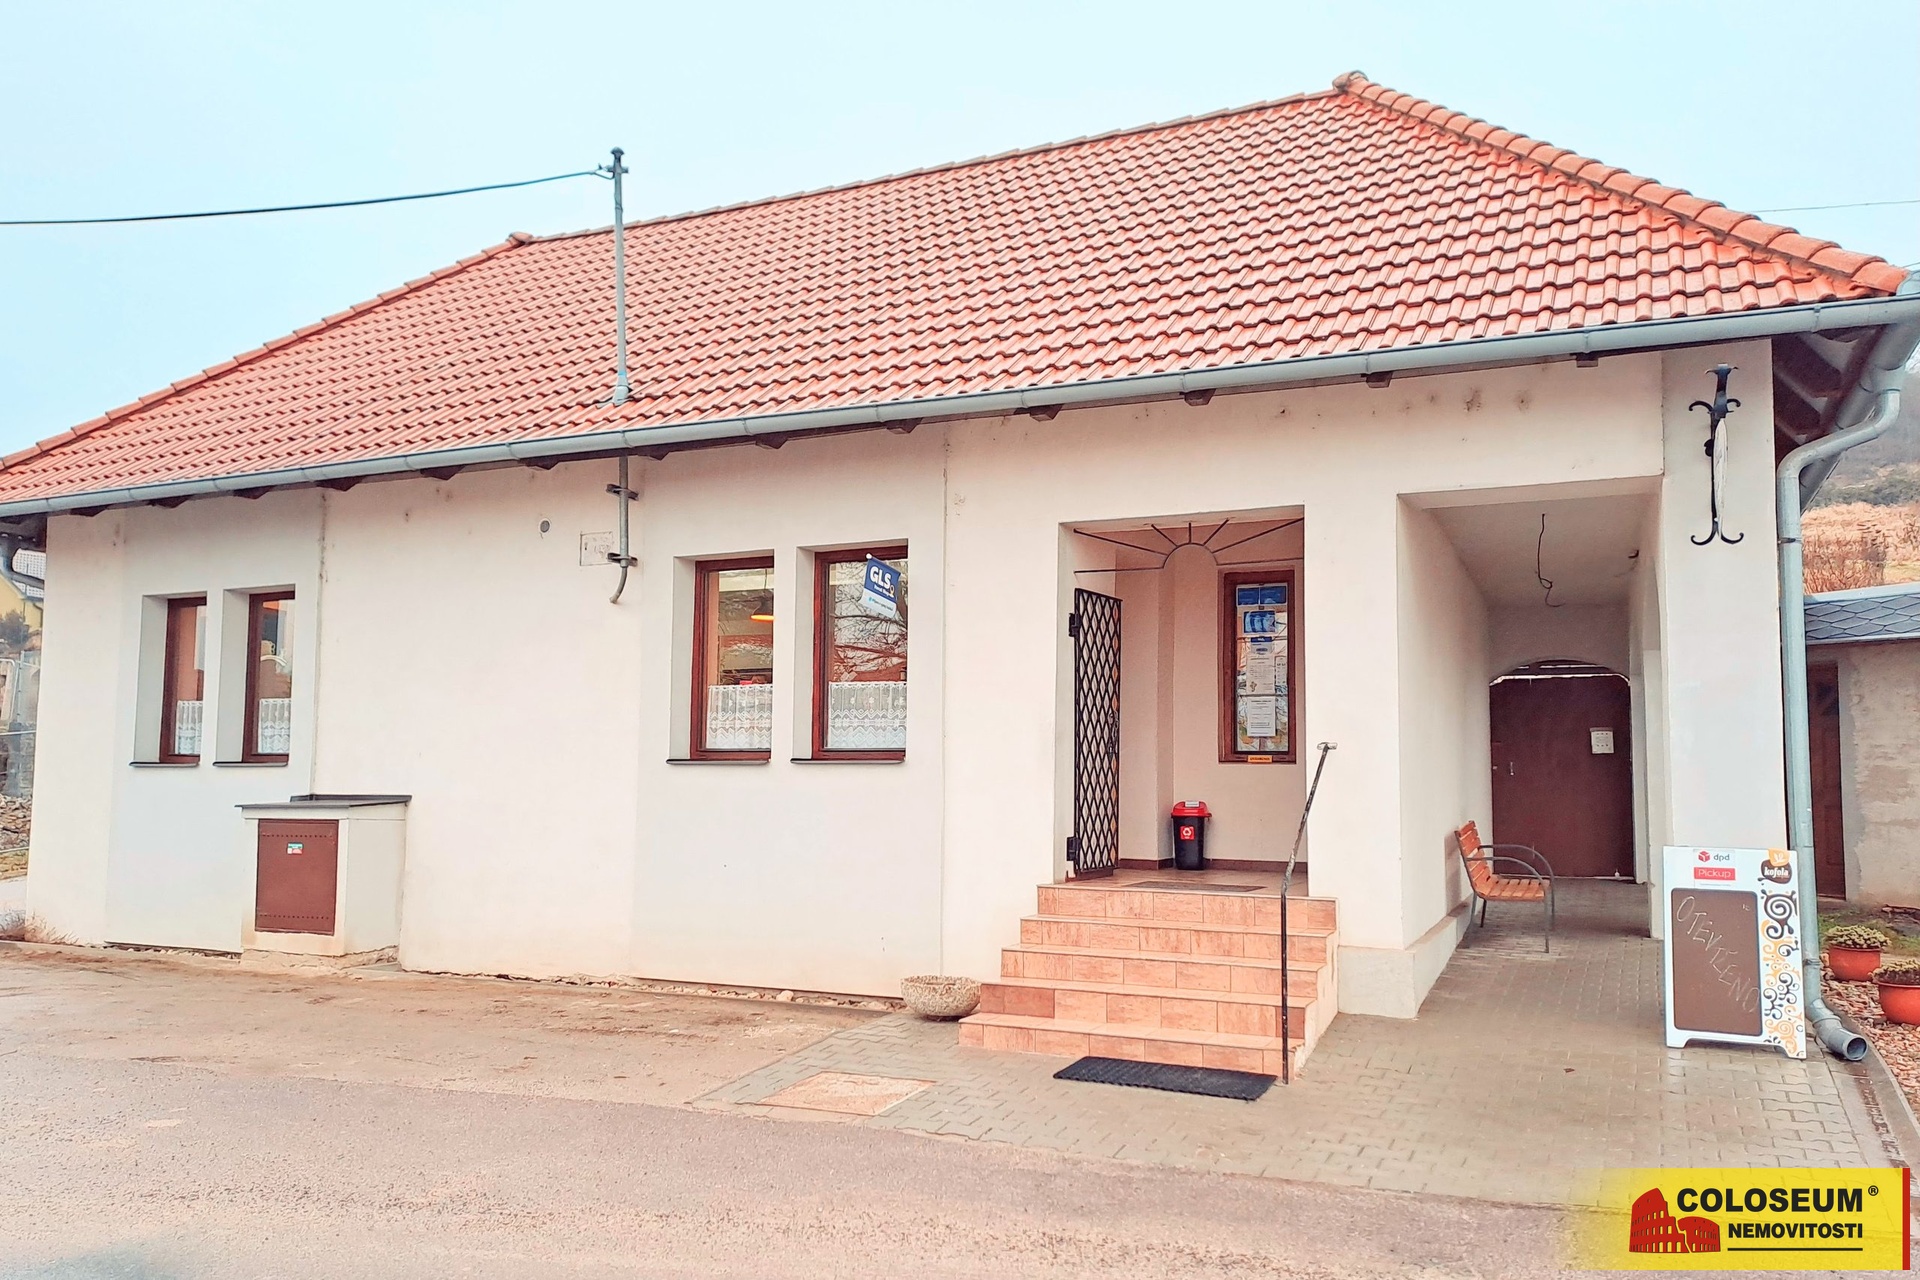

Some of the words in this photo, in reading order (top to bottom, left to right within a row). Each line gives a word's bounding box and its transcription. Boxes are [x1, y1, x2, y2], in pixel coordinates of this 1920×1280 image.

[870, 566, 892, 589] GLS
[1713, 853, 1730, 862] dpd
[1698, 868, 1732, 879] Pickup
[1764, 866, 1789, 878] kofola
